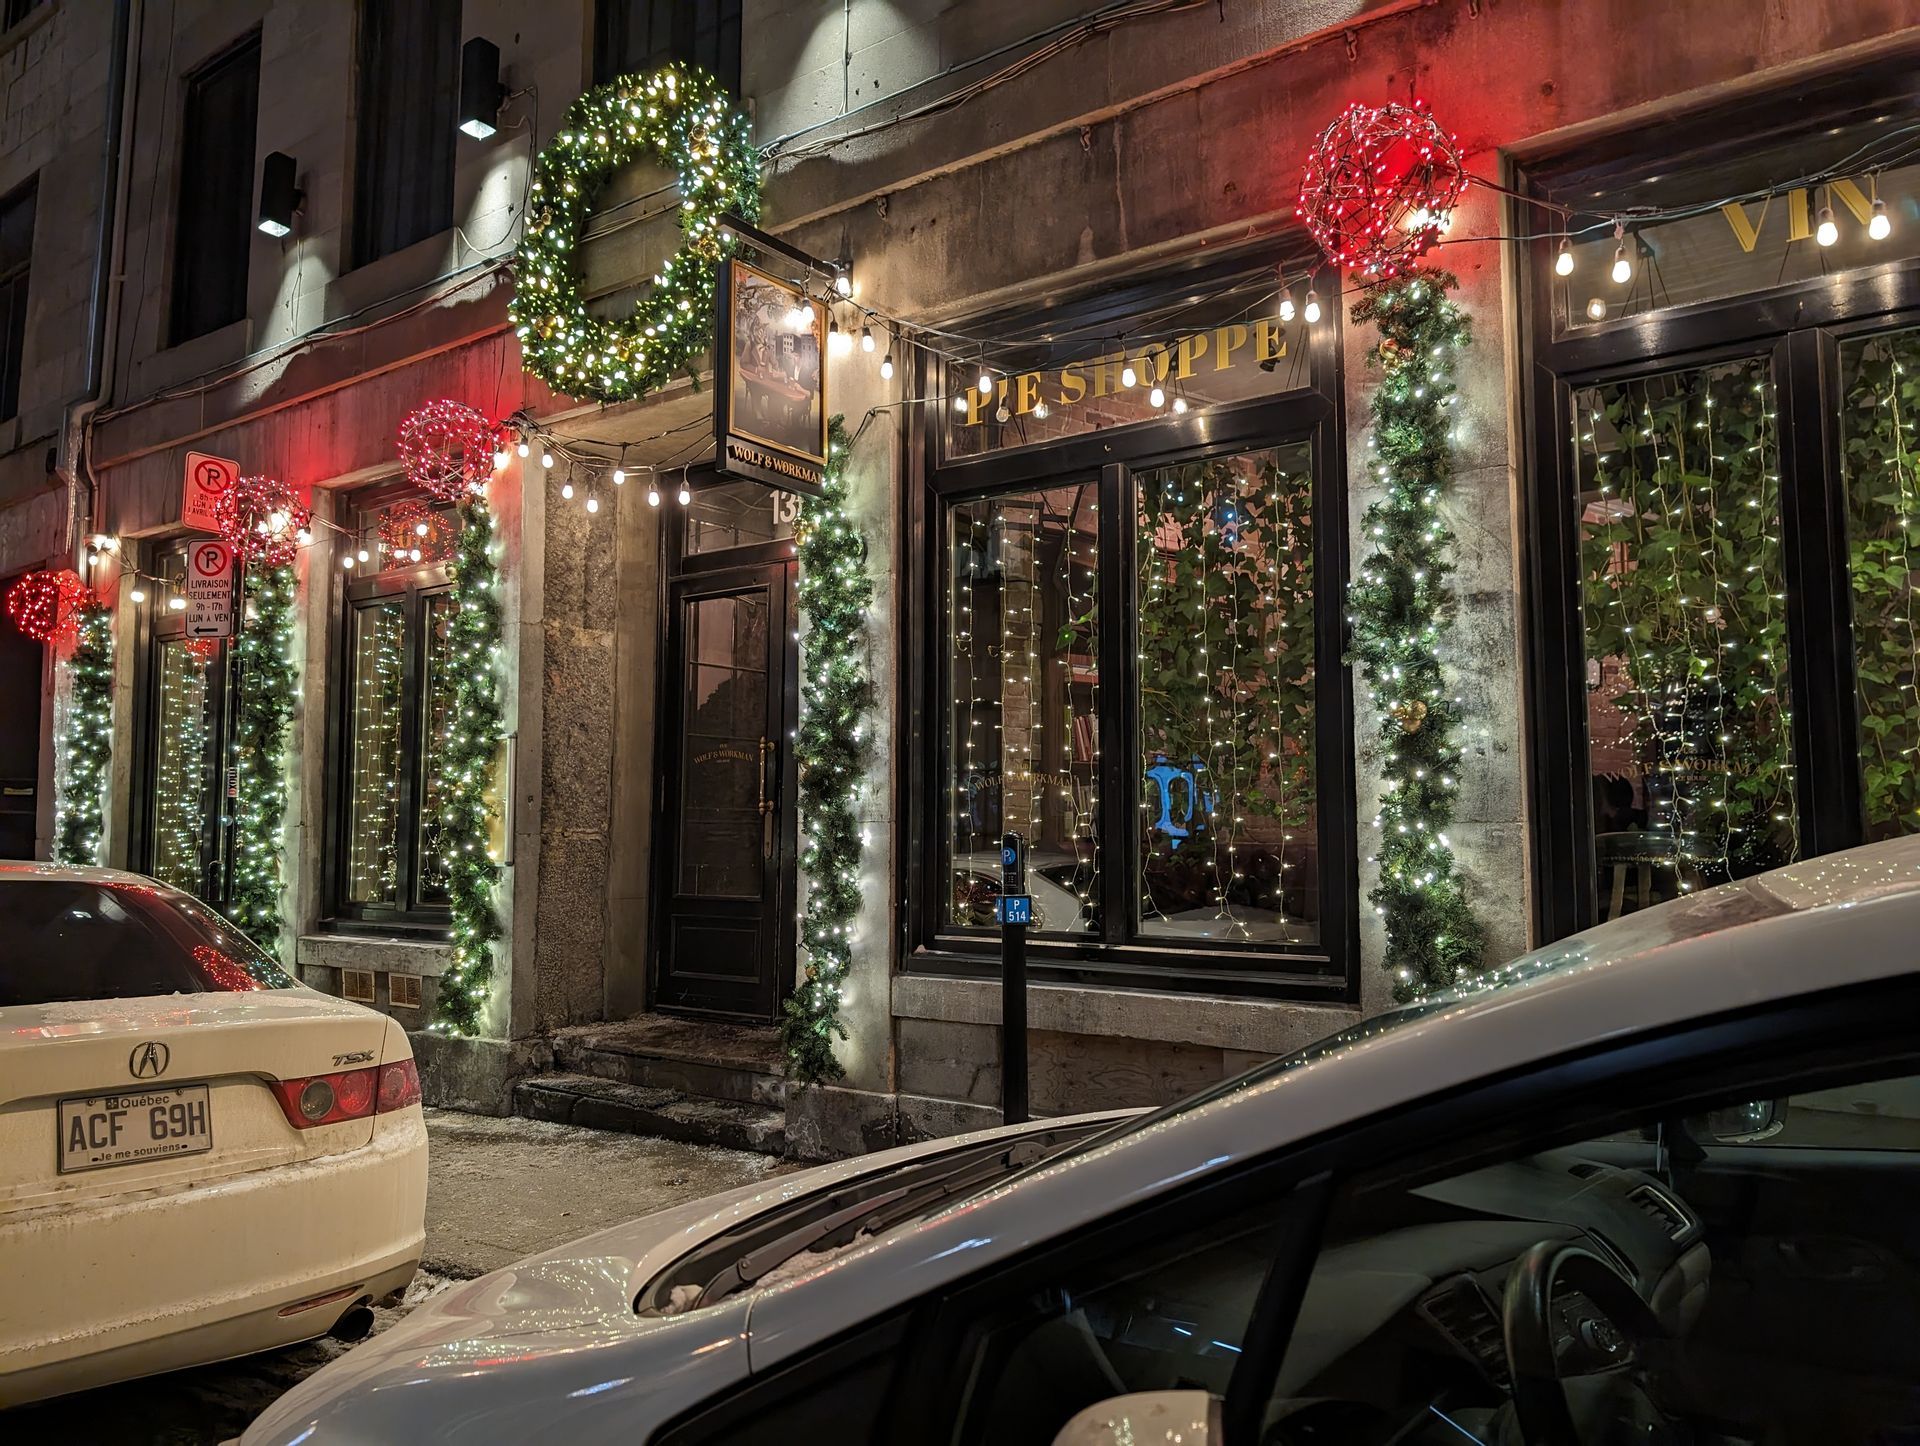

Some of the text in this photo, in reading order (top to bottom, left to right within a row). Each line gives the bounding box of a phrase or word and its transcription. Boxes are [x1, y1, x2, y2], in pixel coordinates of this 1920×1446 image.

[964, 320, 1288, 426] PIE SHOPPE
[734, 445, 764, 464] WOLF
[765, 455, 772, 468] &
[207, 468, 220, 486] P
[192, 507, 208, 517] AVRIL
[769, 489, 803, 525] 13
[206, 551, 218, 569] P
[191, 580, 229, 589] LIVRAISON
[188, 590, 231, 600] SEULEMENT
[195, 602, 205, 611] 9h
[211, 602, 223, 611] 17h
[188, 613, 203, 623] LUN
[214, 613, 229, 622] VEN
[1603, 761, 1654, 784] WOLF
[975, 775, 1004, 790] WOLF
[1013, 899, 1020, 910] P
[1008, 911, 1026, 921] 514
[332, 1050, 375, 1066] TSX
[120, 1095, 170, 1109] Québec
[69, 1101, 206, 1152] ACF 69H
[99, 1144, 180, 1162] Je me souviens
